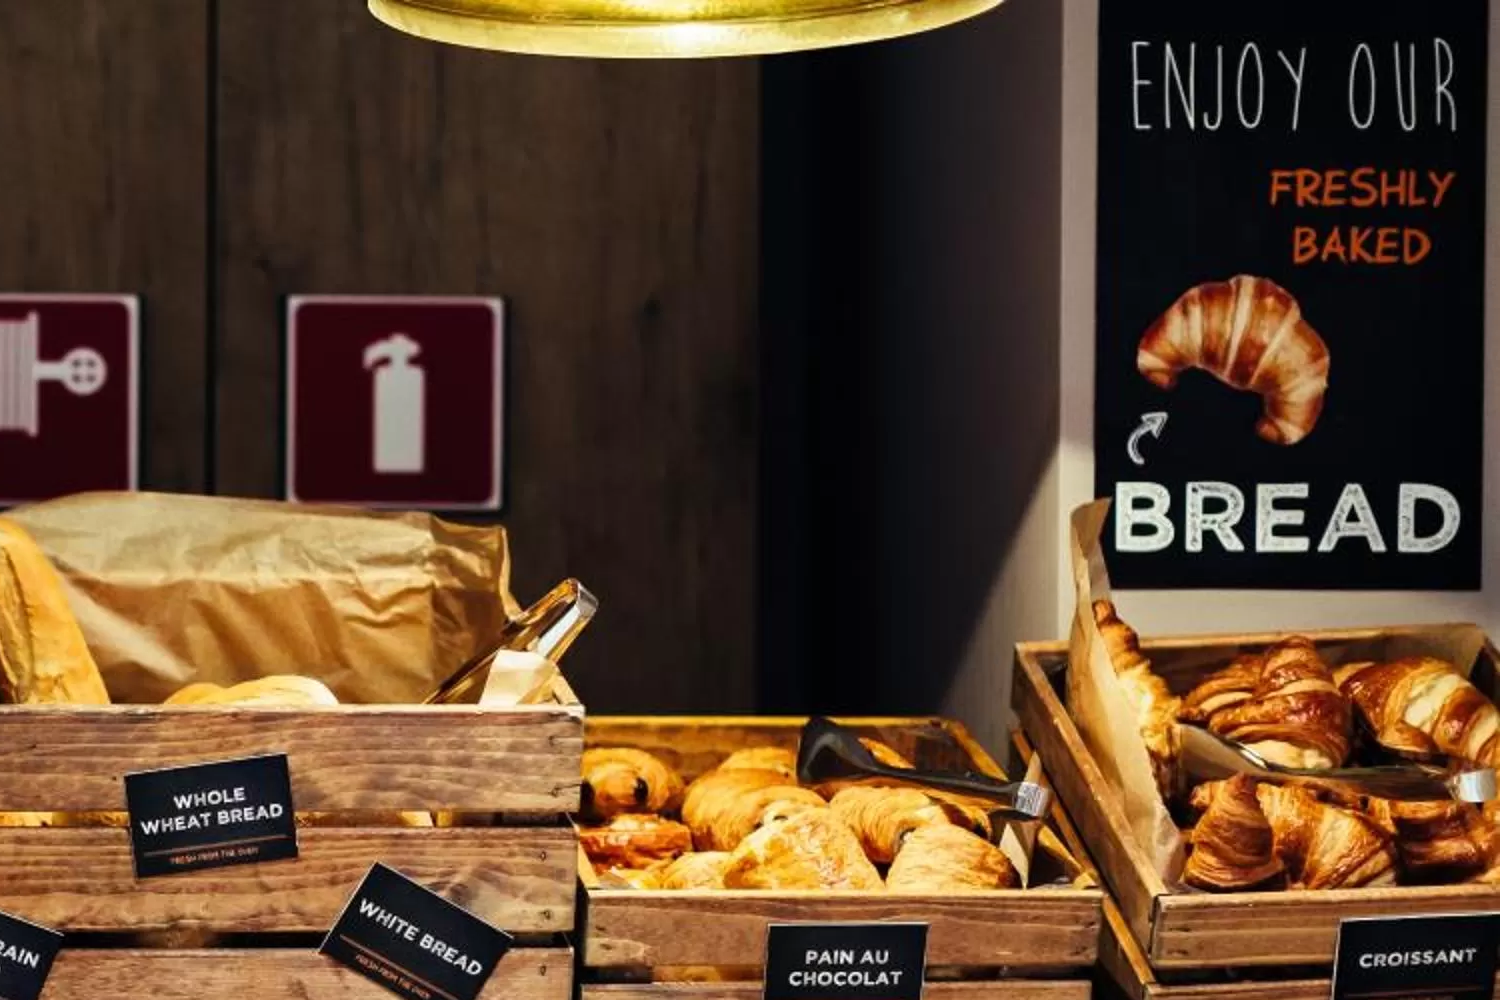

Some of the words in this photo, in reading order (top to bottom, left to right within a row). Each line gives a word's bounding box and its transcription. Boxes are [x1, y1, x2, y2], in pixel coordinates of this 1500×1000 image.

[1131, 41, 1306, 131] ENJOY
[1349, 38, 1456, 131] OUR
[1270, 168, 1455, 207] FRESHLY
[1292, 227, 1431, 264] BAKED
[1115, 481, 1461, 553] BREAD
[173, 787, 246, 809] WHOLE
[140, 813, 212, 836] WHEAT
[217, 803, 284, 826] BREAD
[359, 898, 418, 942] WHITE
[419, 934, 483, 977] BREAD
[805, 950, 854, 965] PAIN
[860, 950, 889, 965] AU
[1359, 948, 1477, 968] CROISSANT
[788, 971, 903, 987] CHOCOLAT
